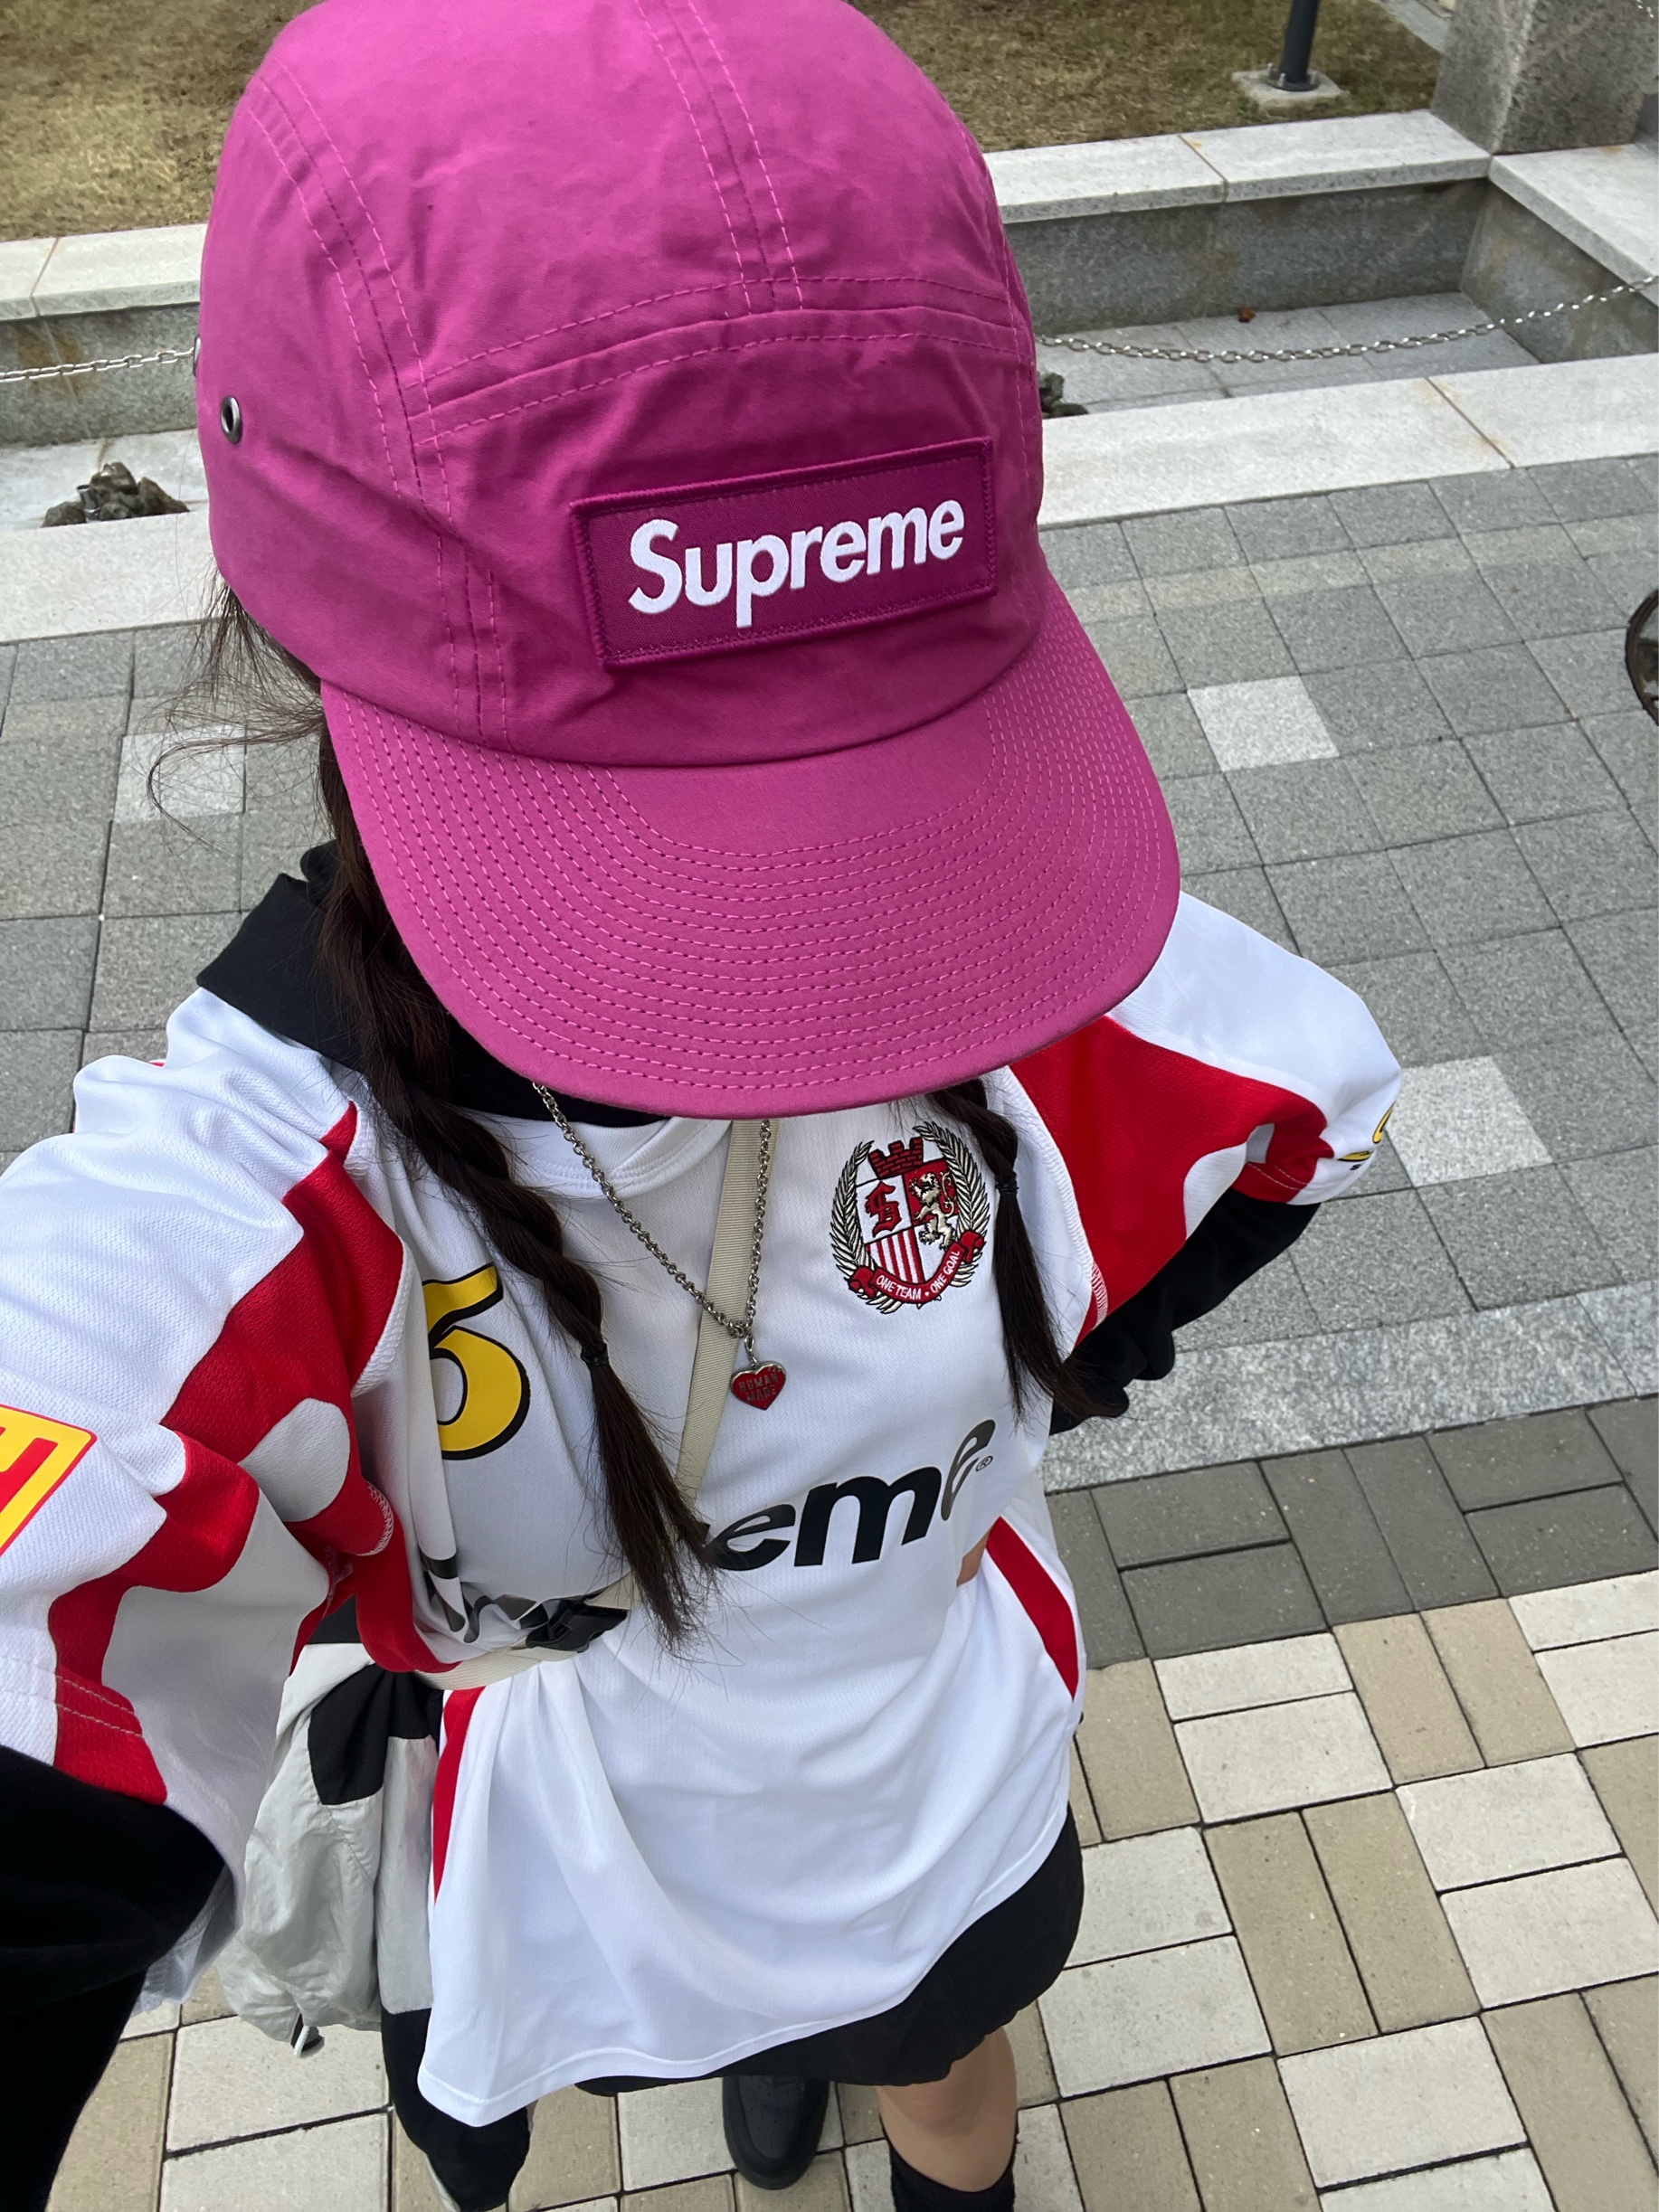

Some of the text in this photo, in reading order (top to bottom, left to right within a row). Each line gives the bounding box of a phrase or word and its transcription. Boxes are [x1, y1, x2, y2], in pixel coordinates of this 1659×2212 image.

[628, 499, 965, 629] Supreme
[876, 1250, 961, 1300] ONE TEAM ONE GOAL
[738, 1373, 779, 1393] HUMAN
[744, 1385, 777, 1402] MADE
